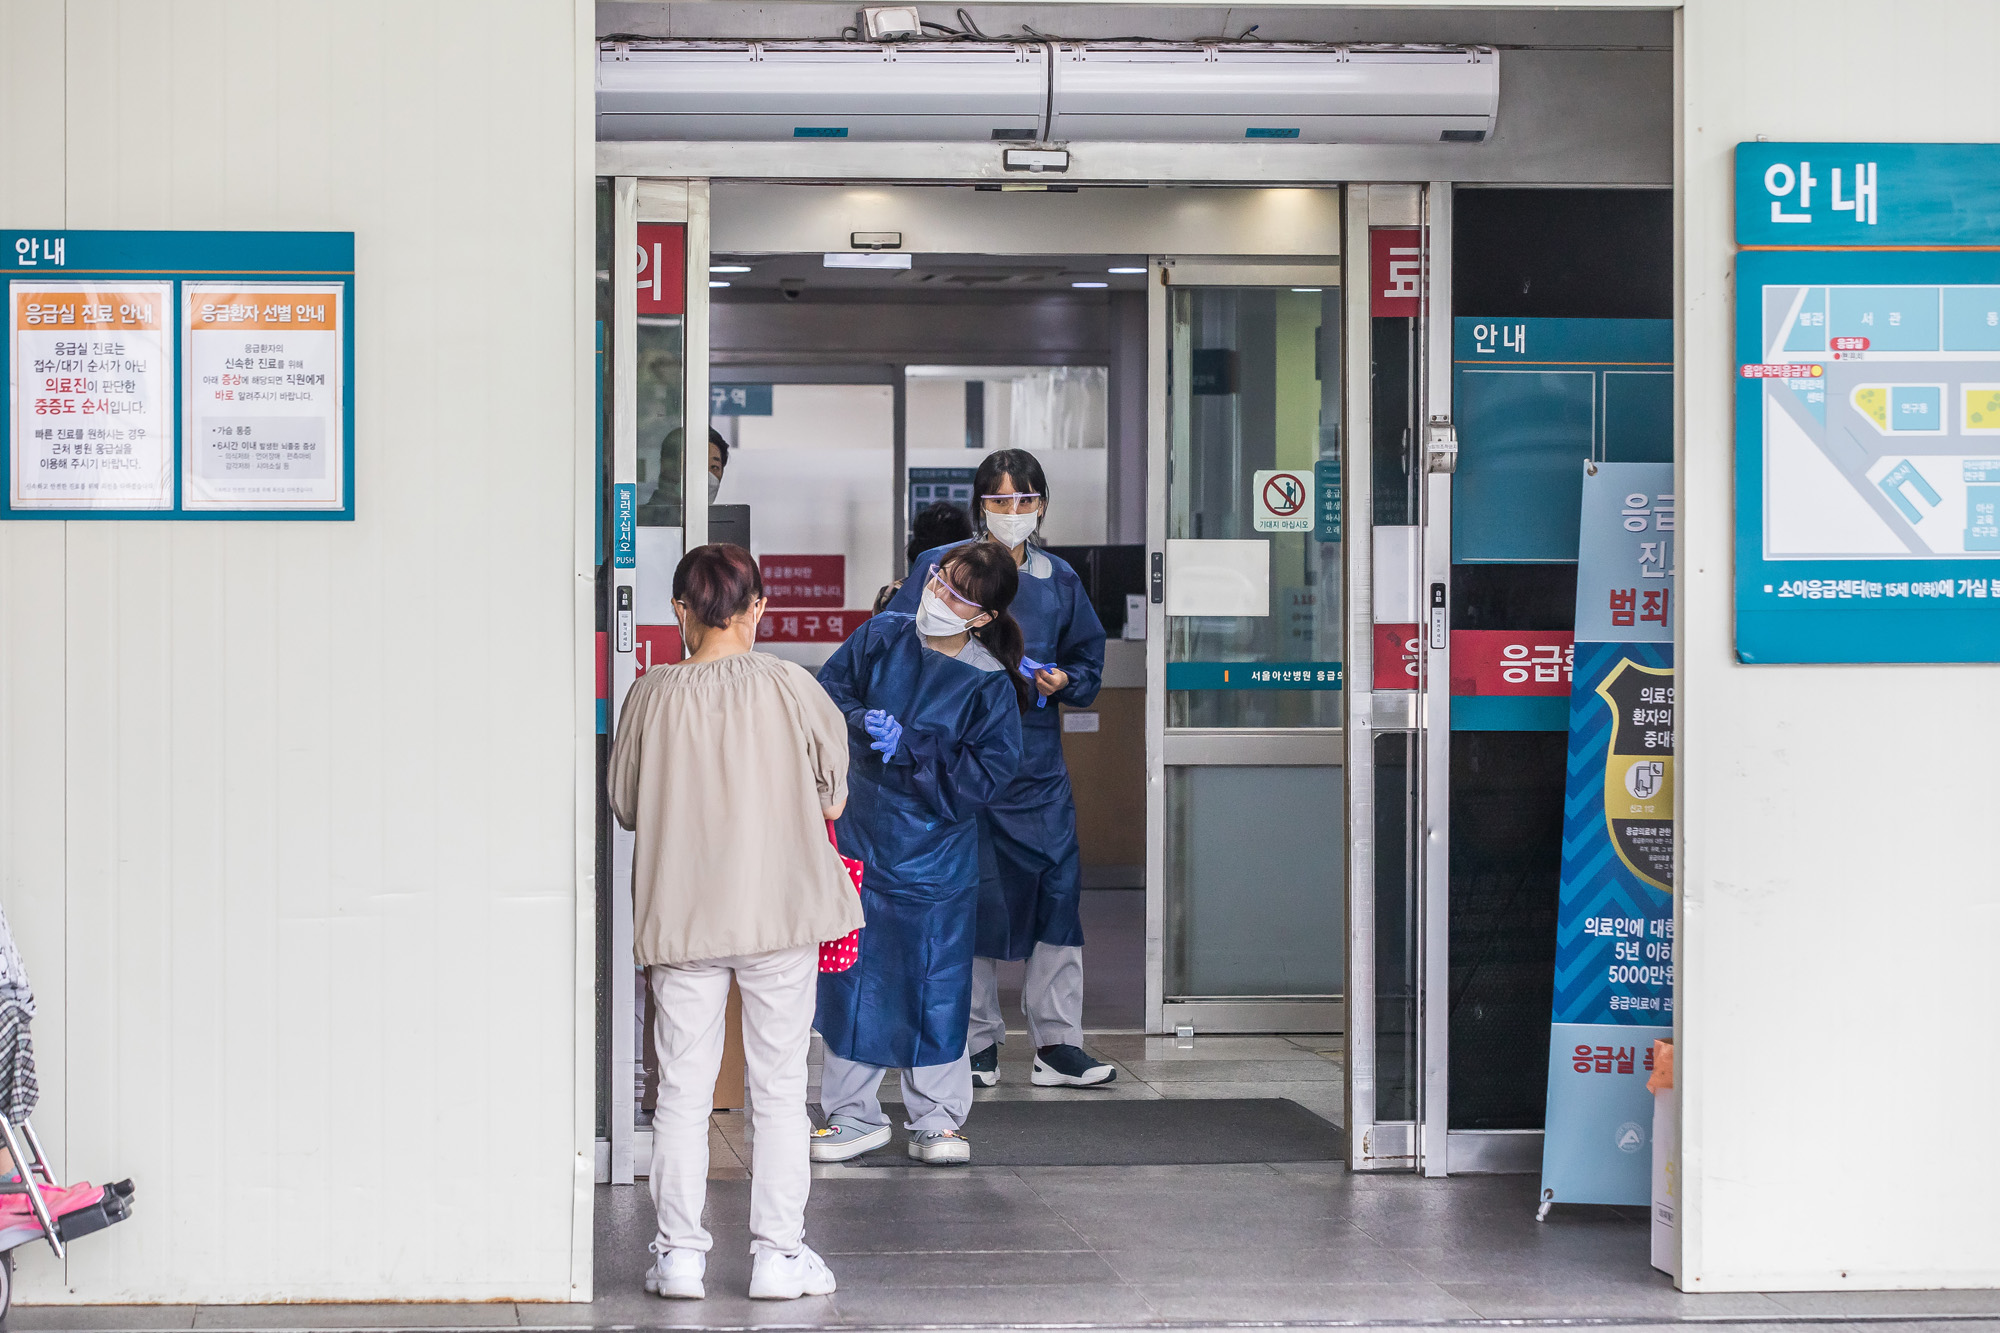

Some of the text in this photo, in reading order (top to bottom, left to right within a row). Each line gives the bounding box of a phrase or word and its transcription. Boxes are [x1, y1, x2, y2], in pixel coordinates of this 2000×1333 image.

[1764, 161, 1877, 225] 안내
[15, 237, 65, 266] 안내
[26, 304, 153, 324] 응급실 진료 안내
[201, 304, 325, 322] 응급환자 선별 안내
[1473, 324, 1525, 353] 안내
[1837, 338, 1864, 349] 응급실
[55, 342, 125, 356] 응급실 진료는
[244, 344, 284, 353] 응급환자의
[34, 359, 146, 373] 접수/대기 순서가 아닌
[225, 358, 303, 370] 신속한 진료를 위해
[1744, 365, 1811, 377] 음압격리응급실
[46, 377, 135, 394] 의료진이 판단한
[203, 374, 325, 386] 아래 증상에 해당되면 직원에게
[215, 390, 313, 401] 바로 알려주시기 바랍니다.
[34, 398, 146, 415] 중증도 순서입니다.
[35, 429, 146, 440] 빠른 진료를 원하시는 경우
[217, 426, 251, 436] 가슴 통증
[52, 443, 132, 454] 근처 병원 응급실을
[217, 442, 238, 450] 6시간
[241, 442, 257, 450] 이내
[40, 458, 141, 469] 이용해 주시기 바랍니다.
[619, 489, 631, 552] 눌러주십시오
[616, 556, 634, 564] PUSH
[1638, 541, 1674, 579] 진
[1778, 579, 1882, 599] 소아응급센터(만
[1957, 579, 1987, 599] 가실
[1610, 587, 1668, 627] 범죄
[1252, 670, 1311, 681] 서울아산병원
[1632, 708, 1671, 726] 환자의
[1584, 917, 1644, 938] 의료인에
[1615, 941, 1639, 961] 5년
[1610, 996, 1660, 1011] 응급의료에
[1572, 1045, 1635, 1074] 응급실
